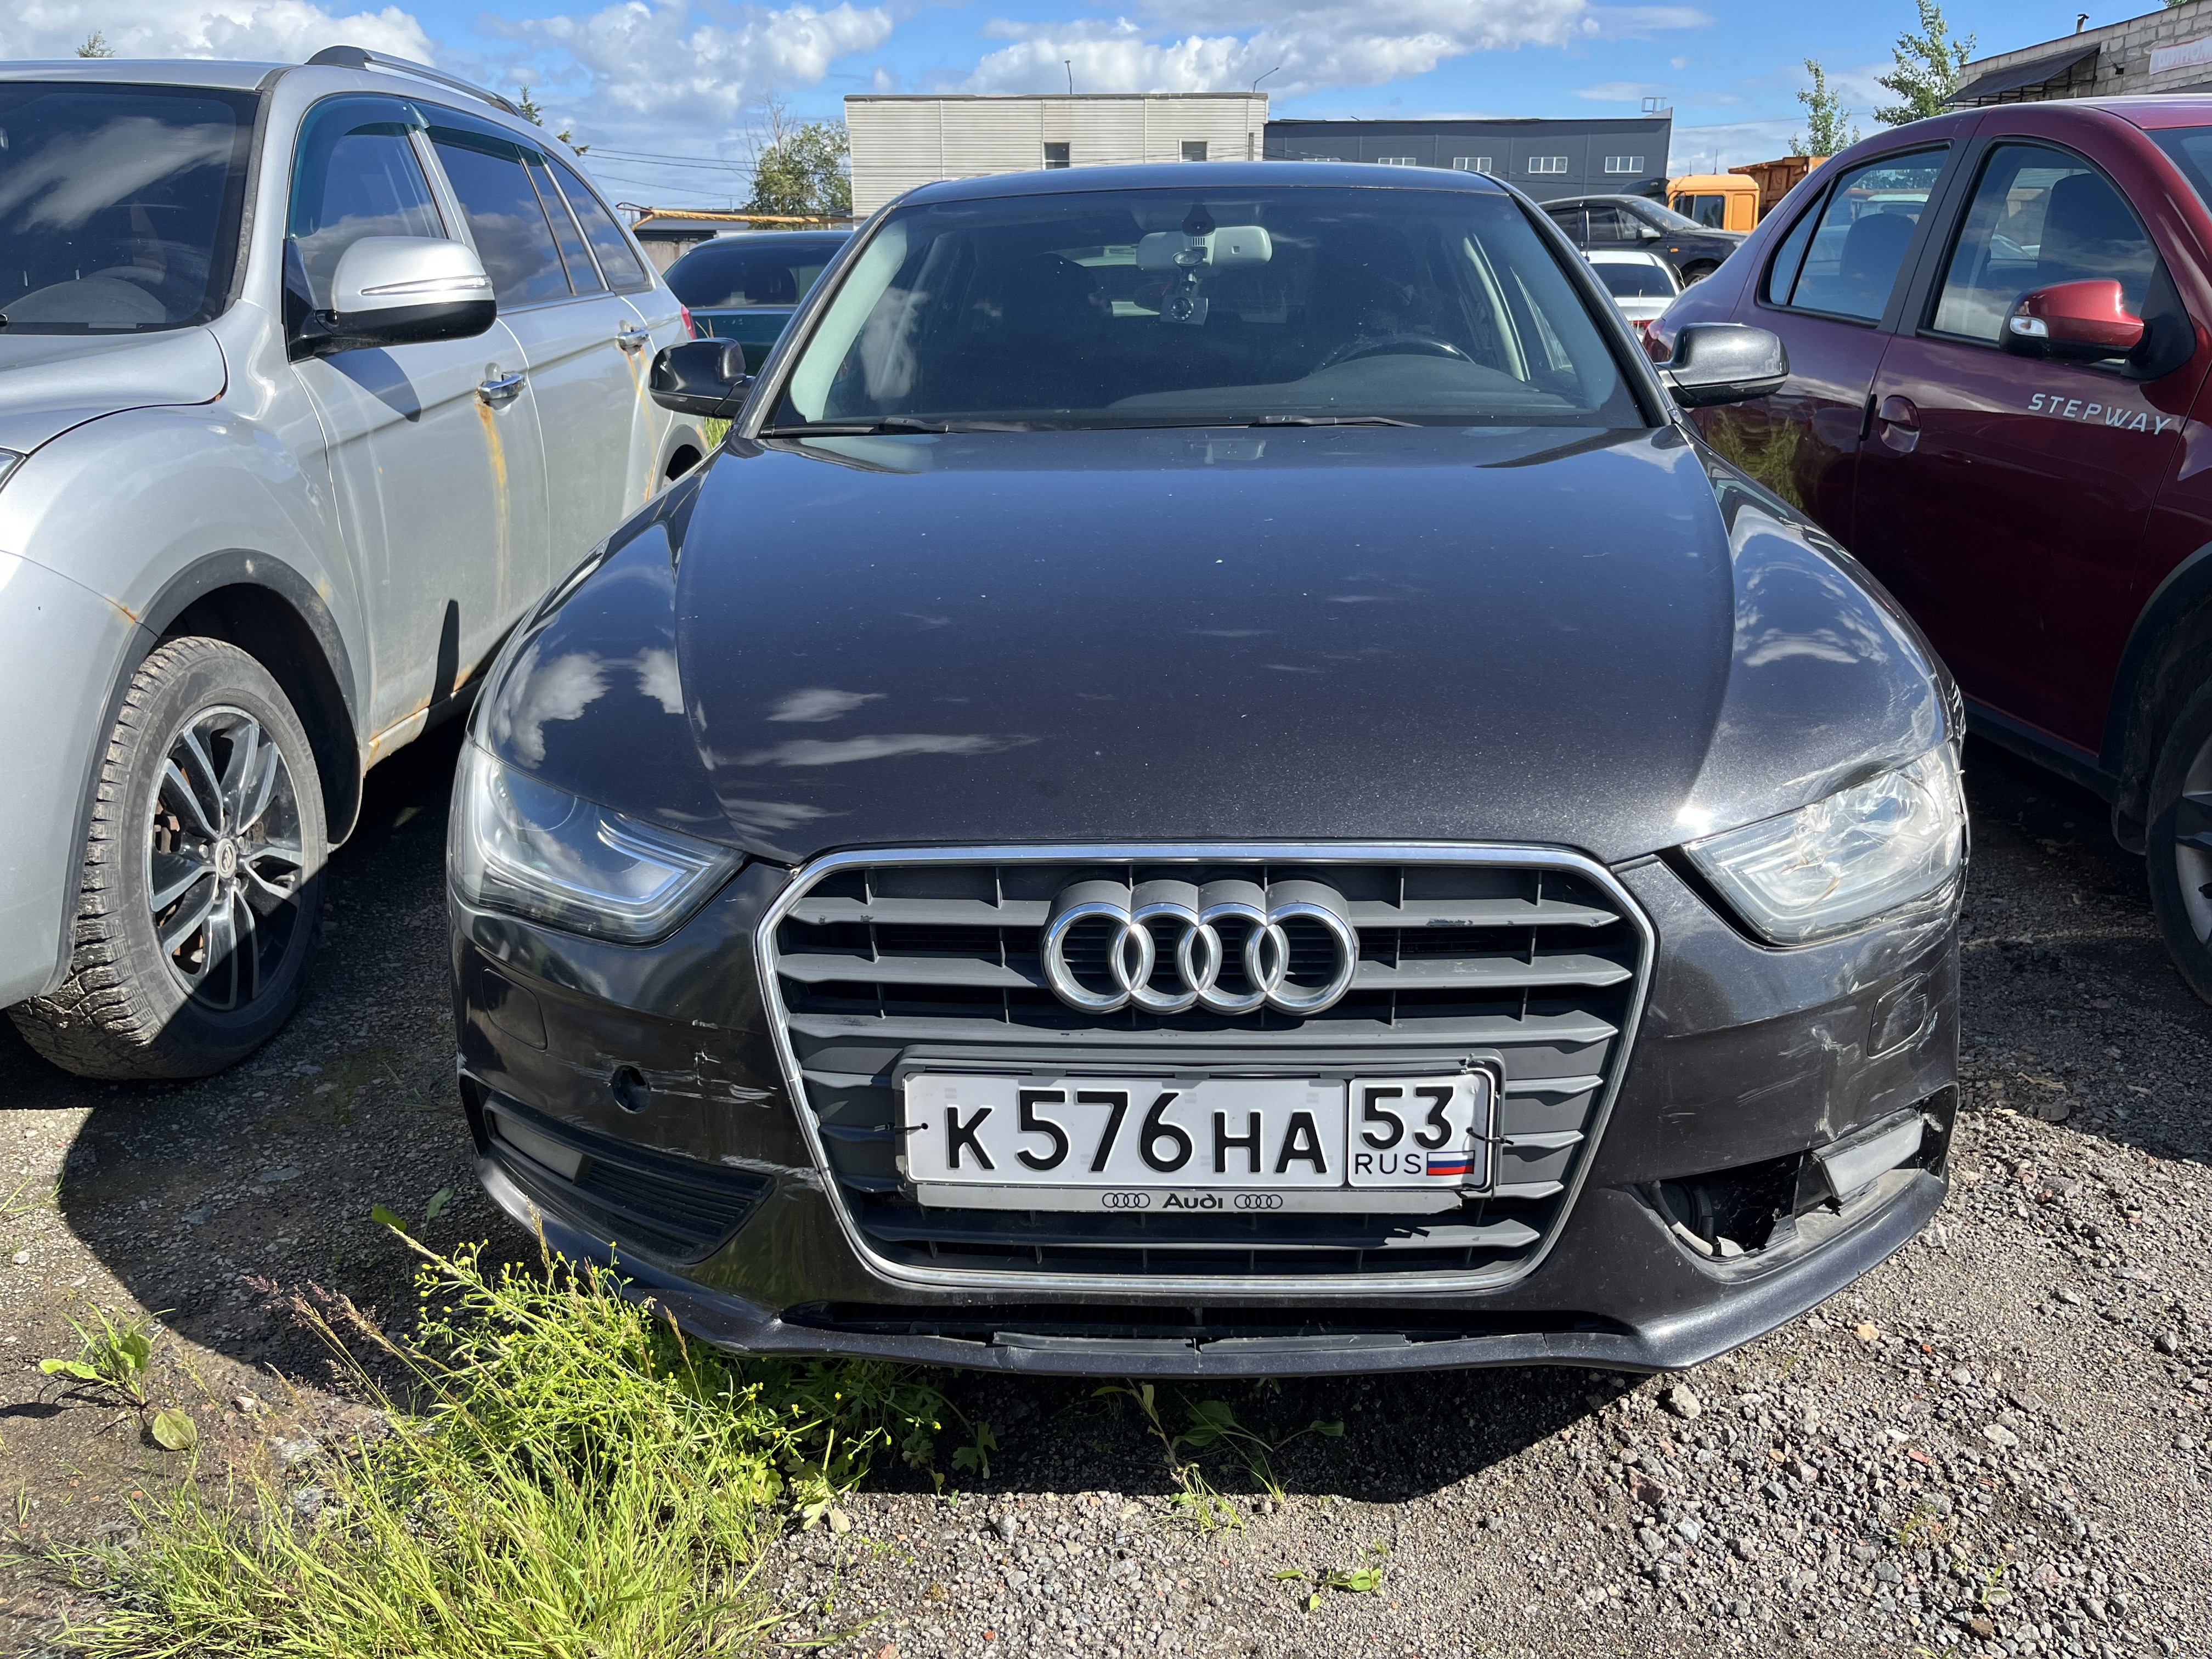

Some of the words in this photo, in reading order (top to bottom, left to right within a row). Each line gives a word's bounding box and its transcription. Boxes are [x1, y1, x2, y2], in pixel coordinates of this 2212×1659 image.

[2028, 393, 2171, 435] STEPWAY
[1362, 1086, 1454, 1150] 53
[1355, 1153, 1421, 1175] RUS
[1163, 1193, 1223, 1209] Audi
